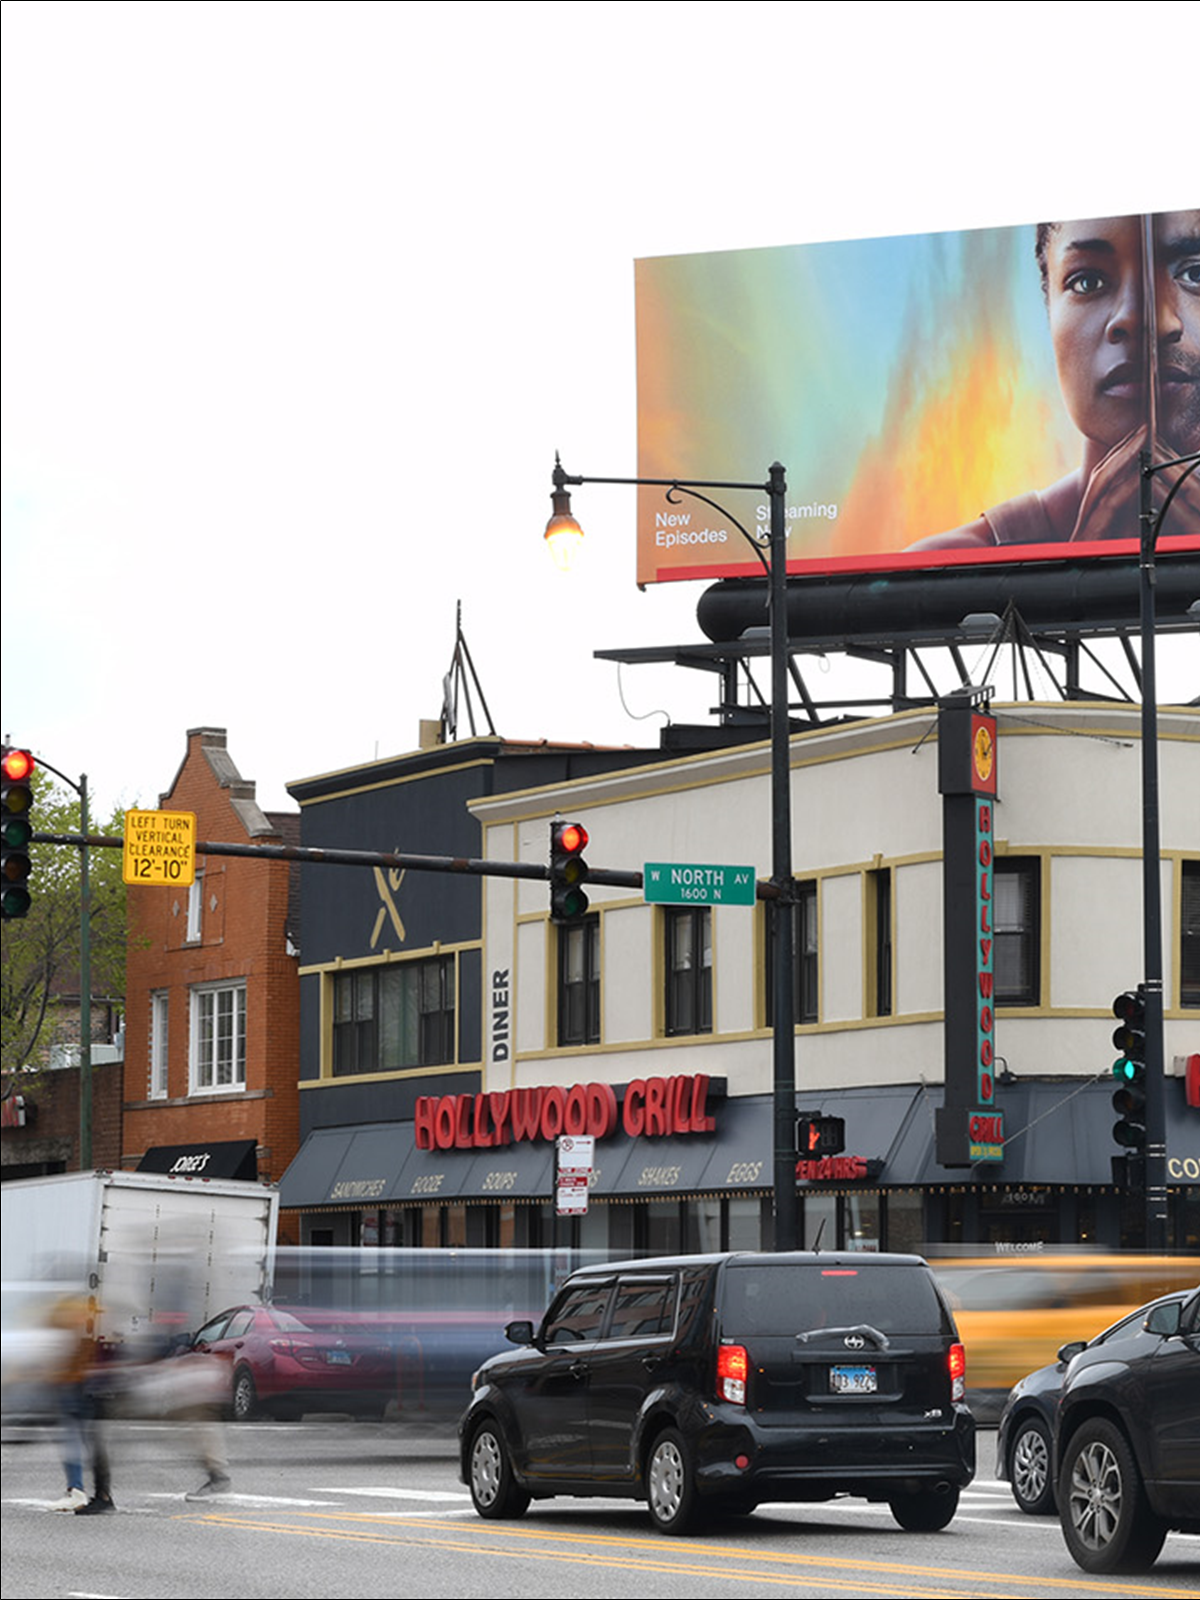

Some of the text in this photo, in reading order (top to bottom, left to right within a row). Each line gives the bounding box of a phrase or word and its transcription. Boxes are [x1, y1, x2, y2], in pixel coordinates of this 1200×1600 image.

[655, 513, 690, 527] New
[655, 529, 728, 548] Episodes
[756, 524, 793, 540] Nw
[131, 816, 190, 830] LEFT TURN
[136, 831, 184, 844] VERTICAL
[129, 844, 190, 858] CLEARANCE
[134, 858, 187, 879] 12'-10"
[651, 869, 749, 886] W NORTH AV
[681, 888, 722, 900] 1600 N
[978, 804, 992, 1101] HOLLYWOOD
[492, 969, 509, 1062] DINER
[414, 1073, 716, 1151] HOLLYWOOD GRILL
[969, 1115, 1005, 1144] GRILL
[482, 1171, 518, 1190] SOUPS
[638, 1165, 682, 1185] SHAKES
[726, 1161, 763, 1183] EGGS
[330, 1179, 386, 1199] SANDWICHES
[995, 1241, 1043, 1253] WELCOME
